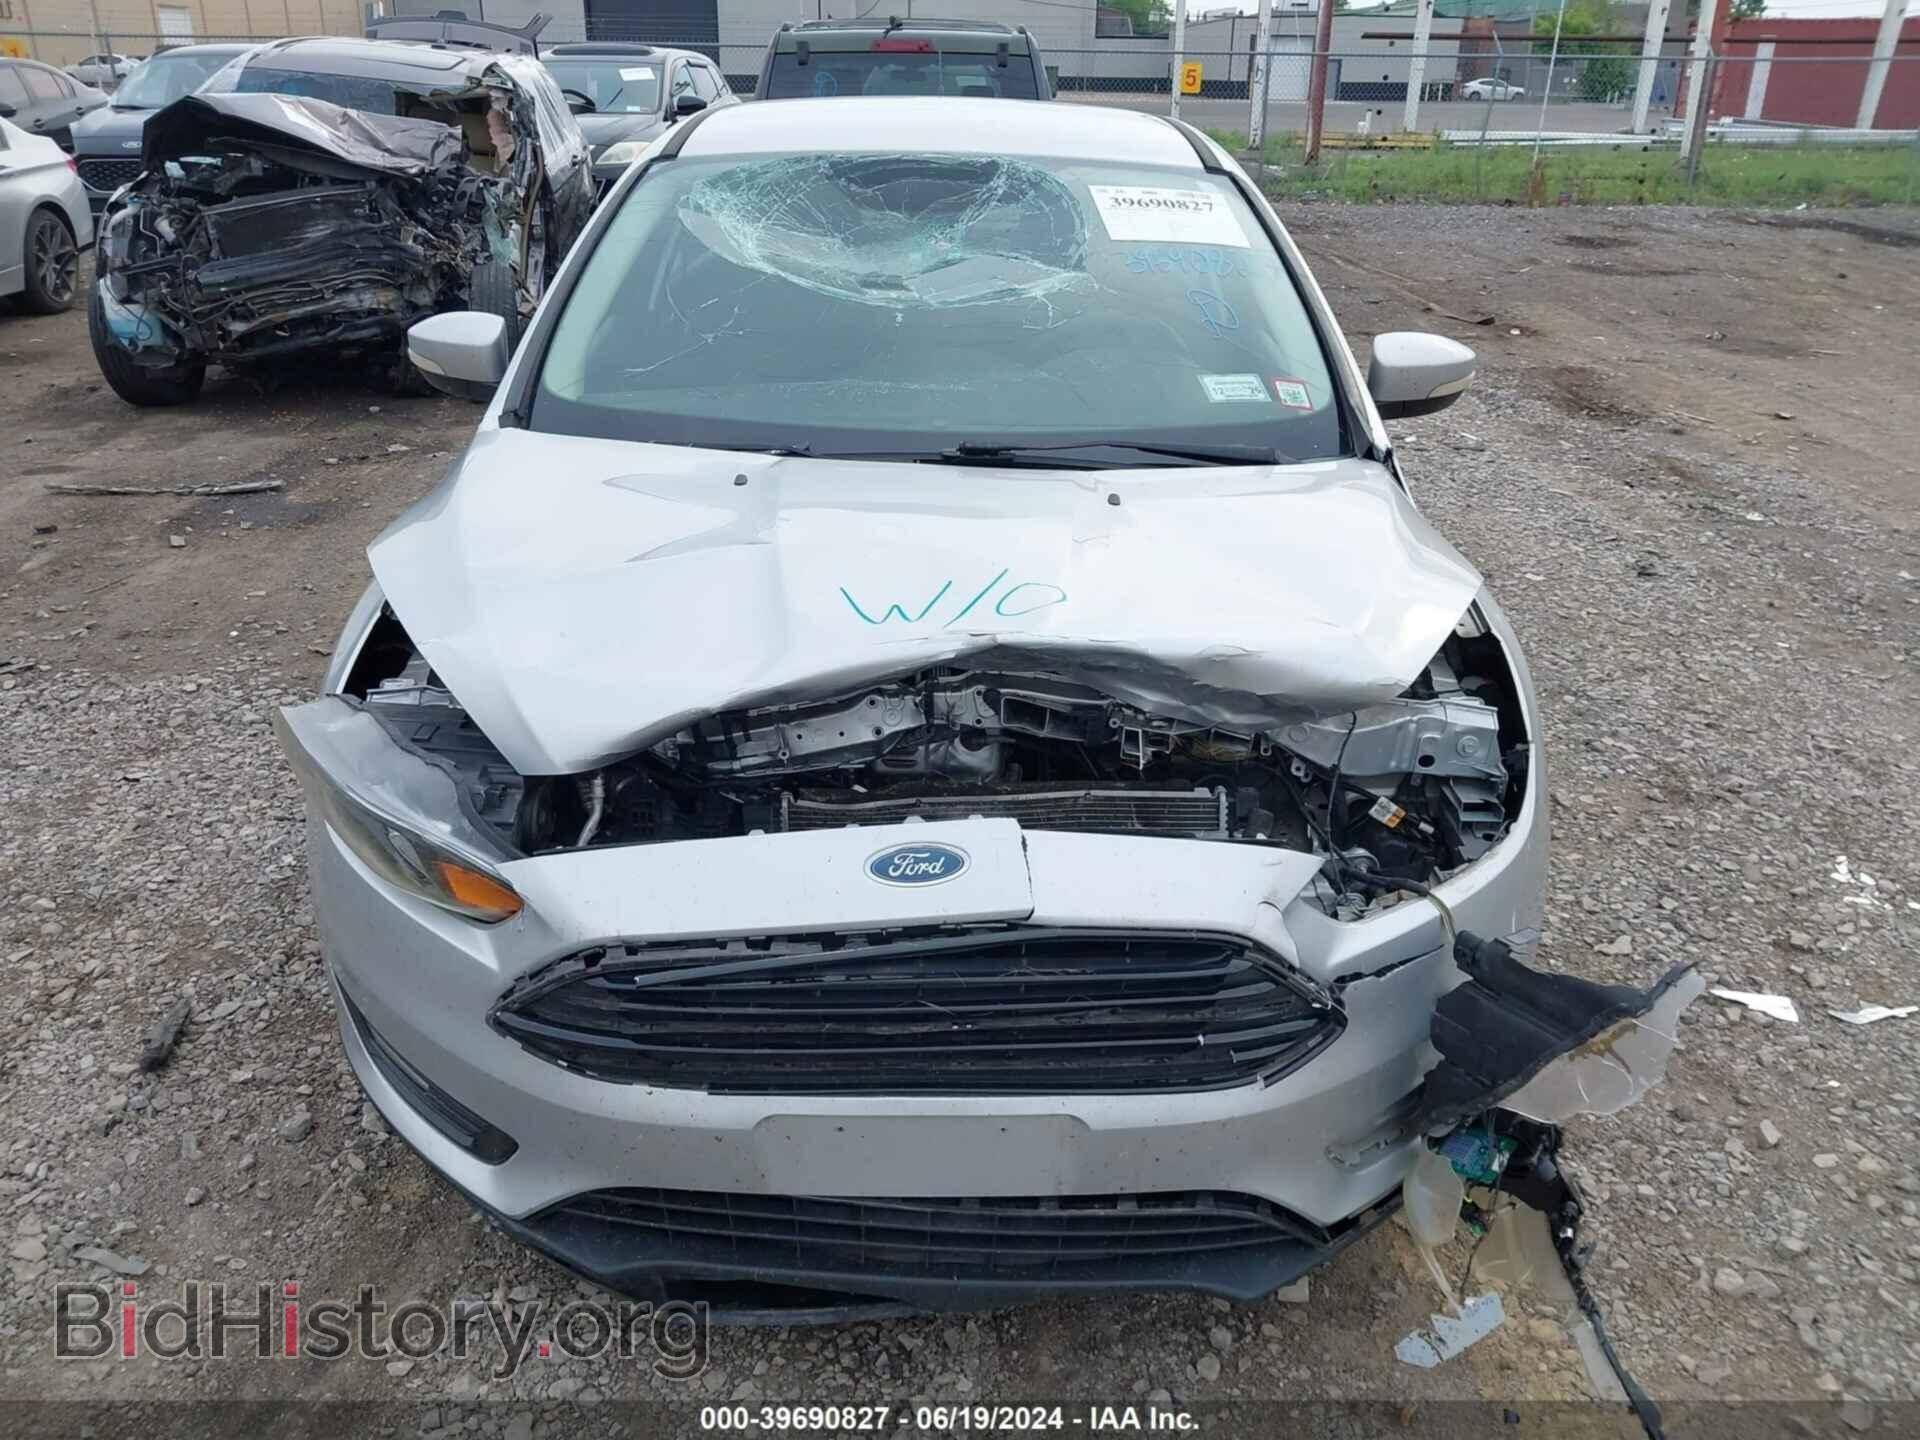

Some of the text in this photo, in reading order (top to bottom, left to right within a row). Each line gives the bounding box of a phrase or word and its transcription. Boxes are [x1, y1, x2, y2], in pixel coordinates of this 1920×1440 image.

[1185, 68, 1197, 87] 5
[1109, 196, 1214, 213] 39690827
[888, 852, 945, 877] Ford
